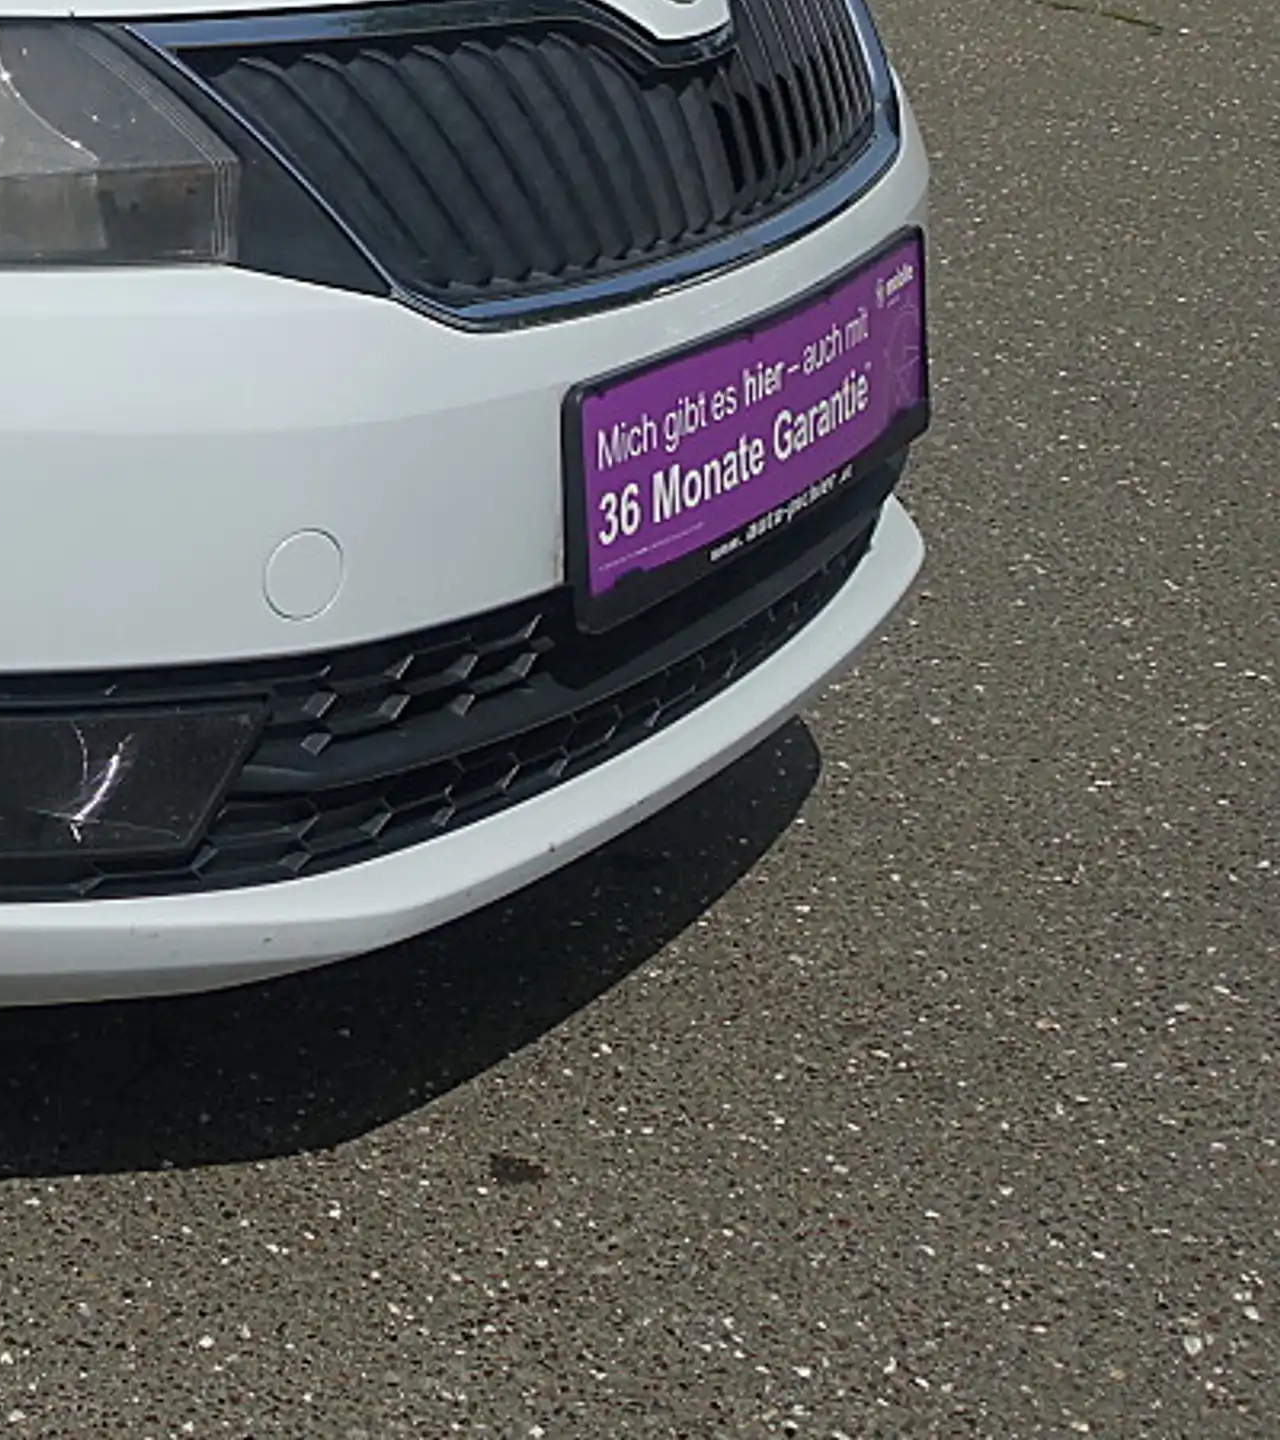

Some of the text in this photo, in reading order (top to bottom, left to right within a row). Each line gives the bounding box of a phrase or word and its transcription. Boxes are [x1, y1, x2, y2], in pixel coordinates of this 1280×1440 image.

[597, 415, 658, 471] Mich
[664, 392, 708, 453] gibt
[711, 386, 738, 421] es
[743, 360, 785, 407] hier
[802, 323, 842, 375] auch
[598, 483, 641, 546] 36
[651, 433, 765, 524] Monate
